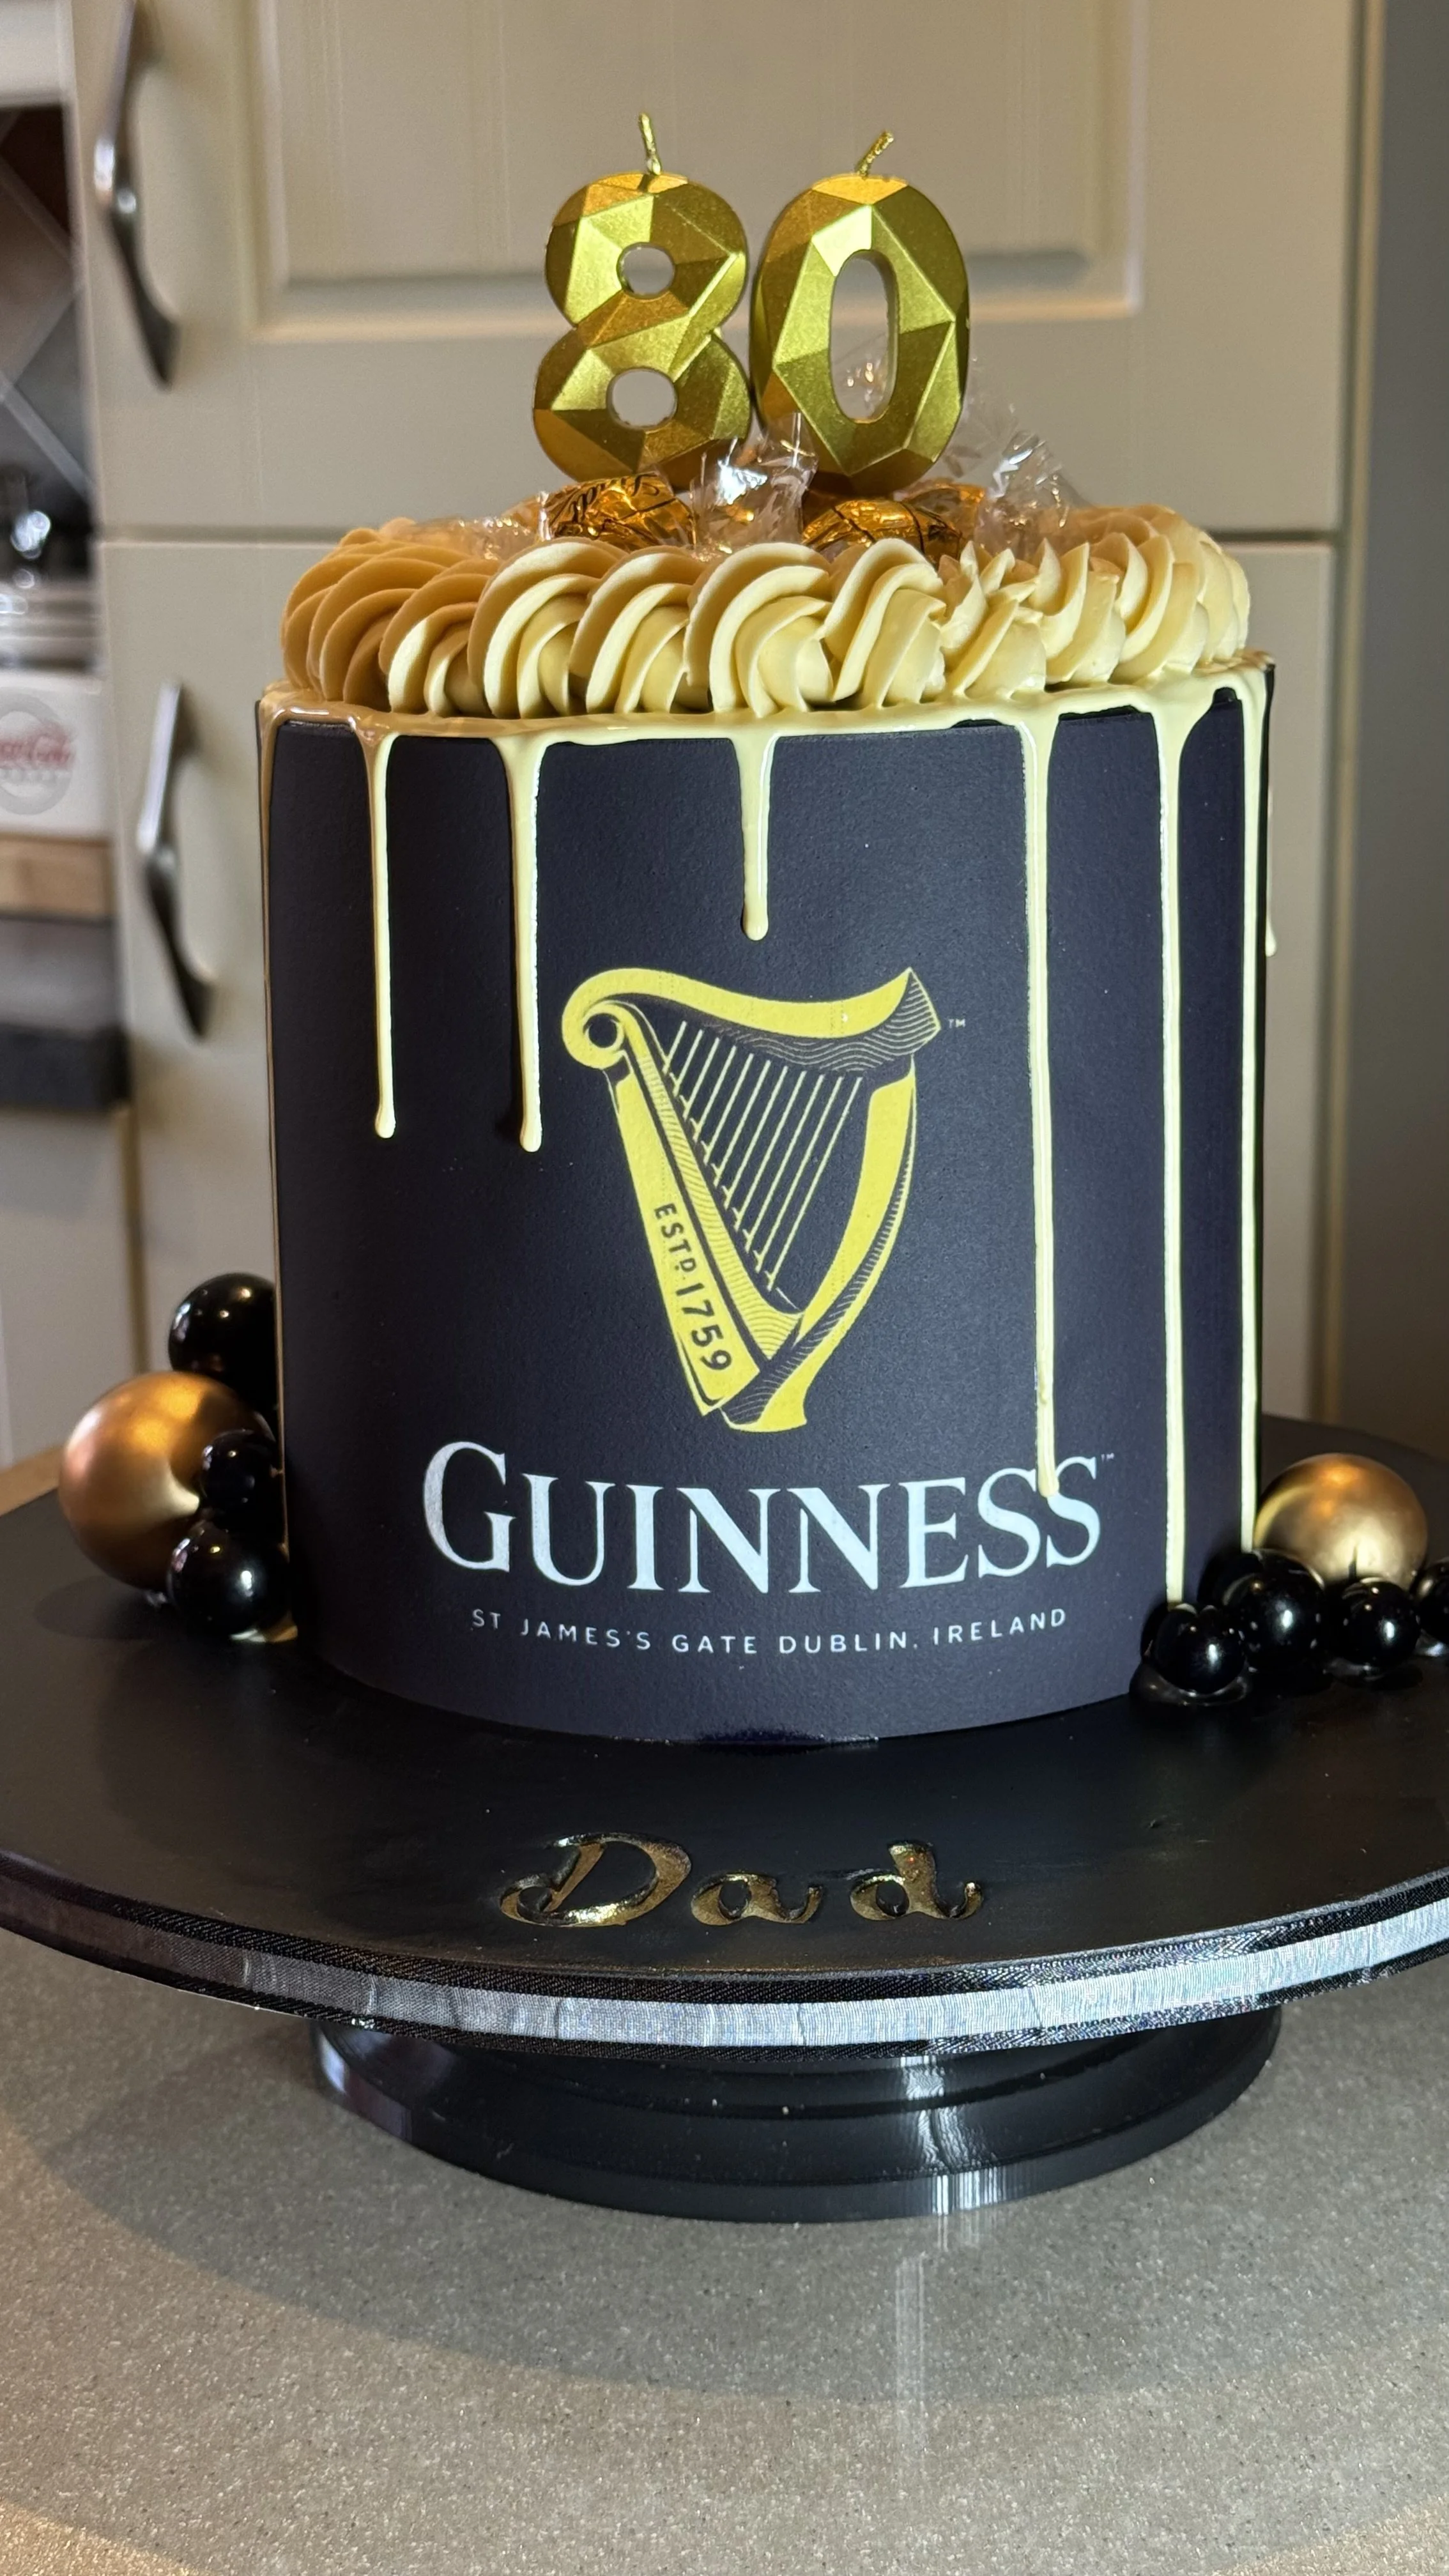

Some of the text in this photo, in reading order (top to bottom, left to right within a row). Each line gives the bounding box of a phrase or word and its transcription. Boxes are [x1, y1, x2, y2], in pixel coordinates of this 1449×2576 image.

[532, 171, 971, 495] 80
[675, 1282, 732, 1371] 1759
[422, 1441, 1101, 1593] GUINNESS
[471, 1608, 501, 1630] ST
[520, 1618, 651, 1650] JAMES'S
[671, 1634, 757, 1654] GATE
[933, 1609, 1065, 1646] IRELAND
[500, 1831, 984, 1927] Dad
